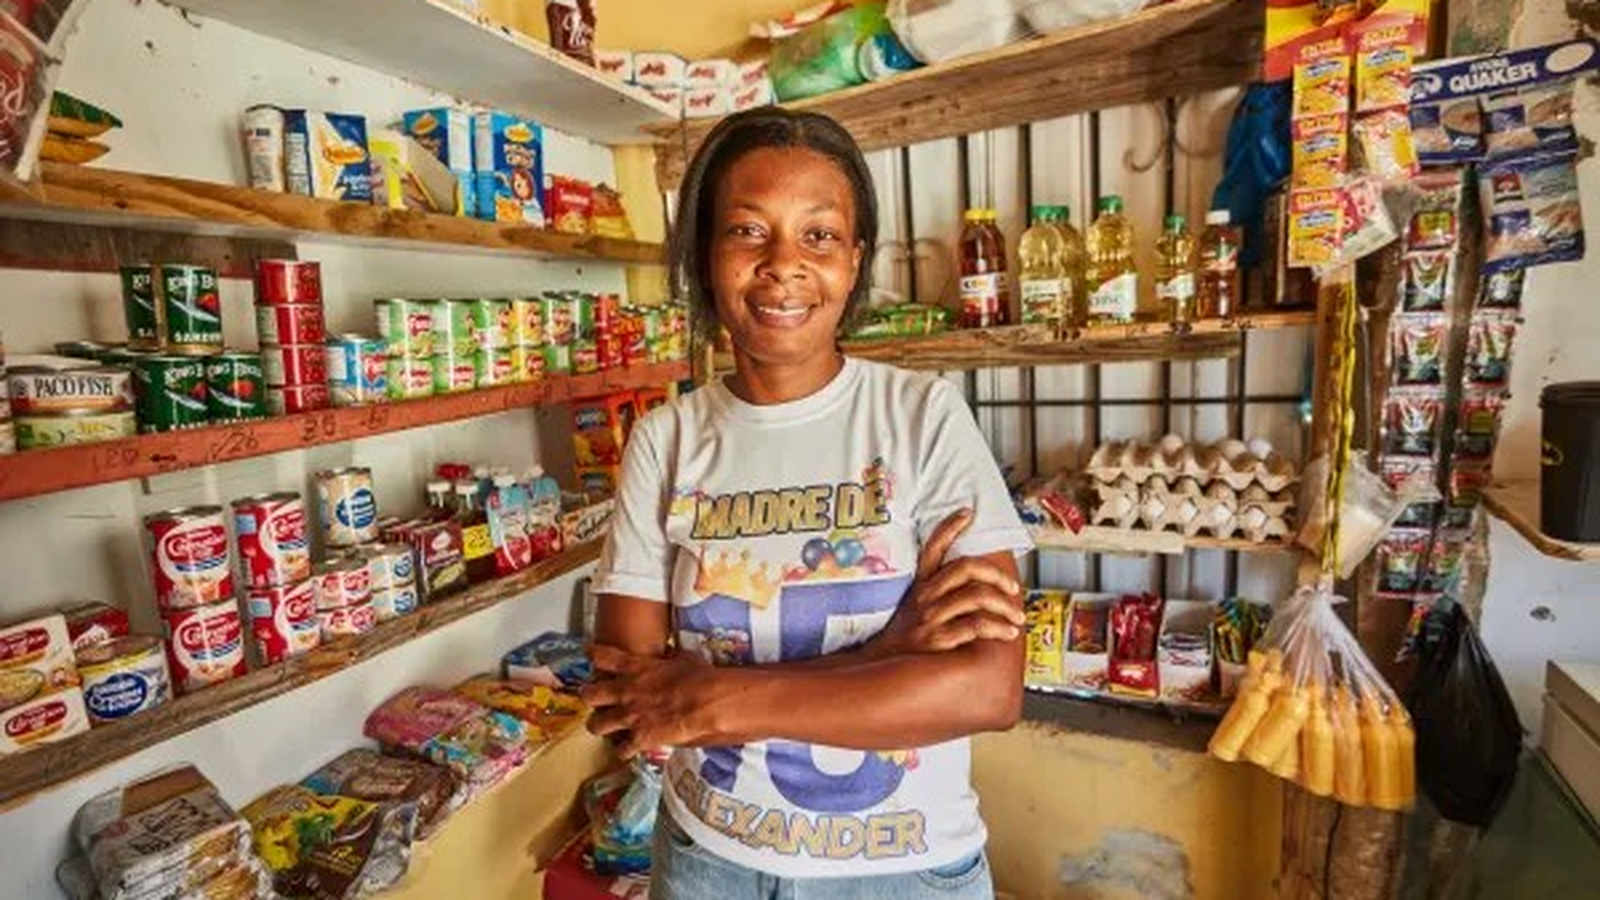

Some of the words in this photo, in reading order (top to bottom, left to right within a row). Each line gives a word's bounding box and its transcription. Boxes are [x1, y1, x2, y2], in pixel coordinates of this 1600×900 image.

[1449, 62, 1538, 93] QUAKER
[34, 377, 76, 398] PACO
[79, 376, 114, 396] FISH
[691, 485, 833, 540] MADRE
[834, 480, 890, 529] DE
